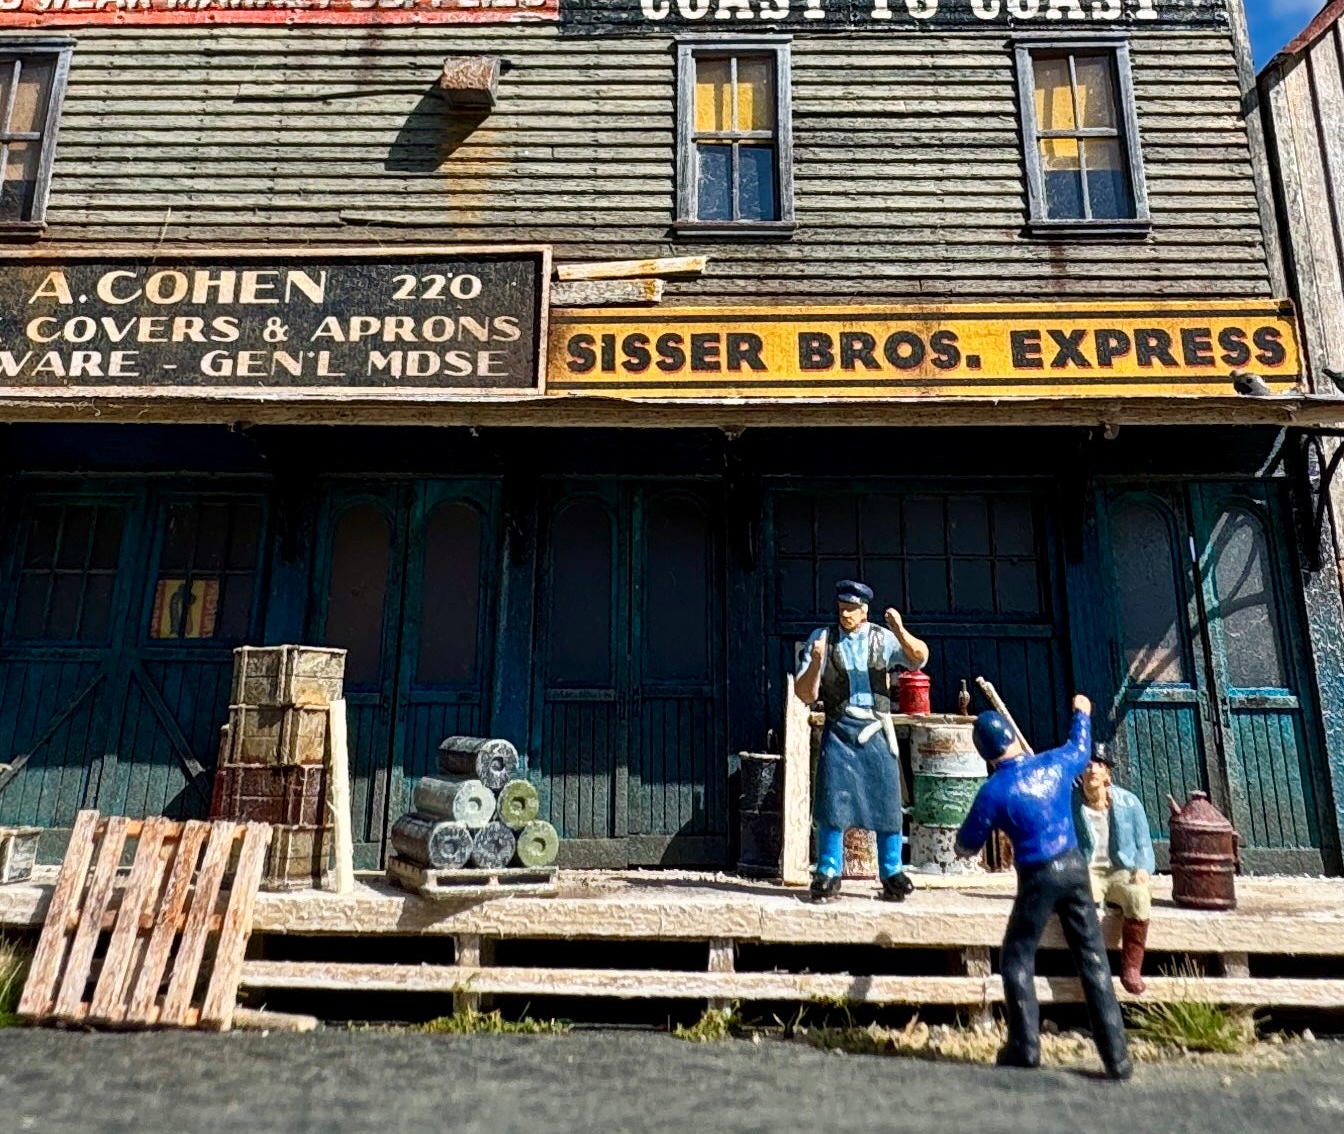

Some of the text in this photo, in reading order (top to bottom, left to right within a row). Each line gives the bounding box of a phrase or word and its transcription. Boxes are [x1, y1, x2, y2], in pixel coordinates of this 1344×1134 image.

[391, 273, 483, 301] 220
[26, 315, 240, 345] COVERS
[262, 315, 289, 343] &
[312, 313, 523, 342] APRONS
[200, 350, 348, 378] GEN'L
[366, 350, 510, 378] MDSE
[565, 326, 1289, 375] SISSER BROS. EXPRESS
